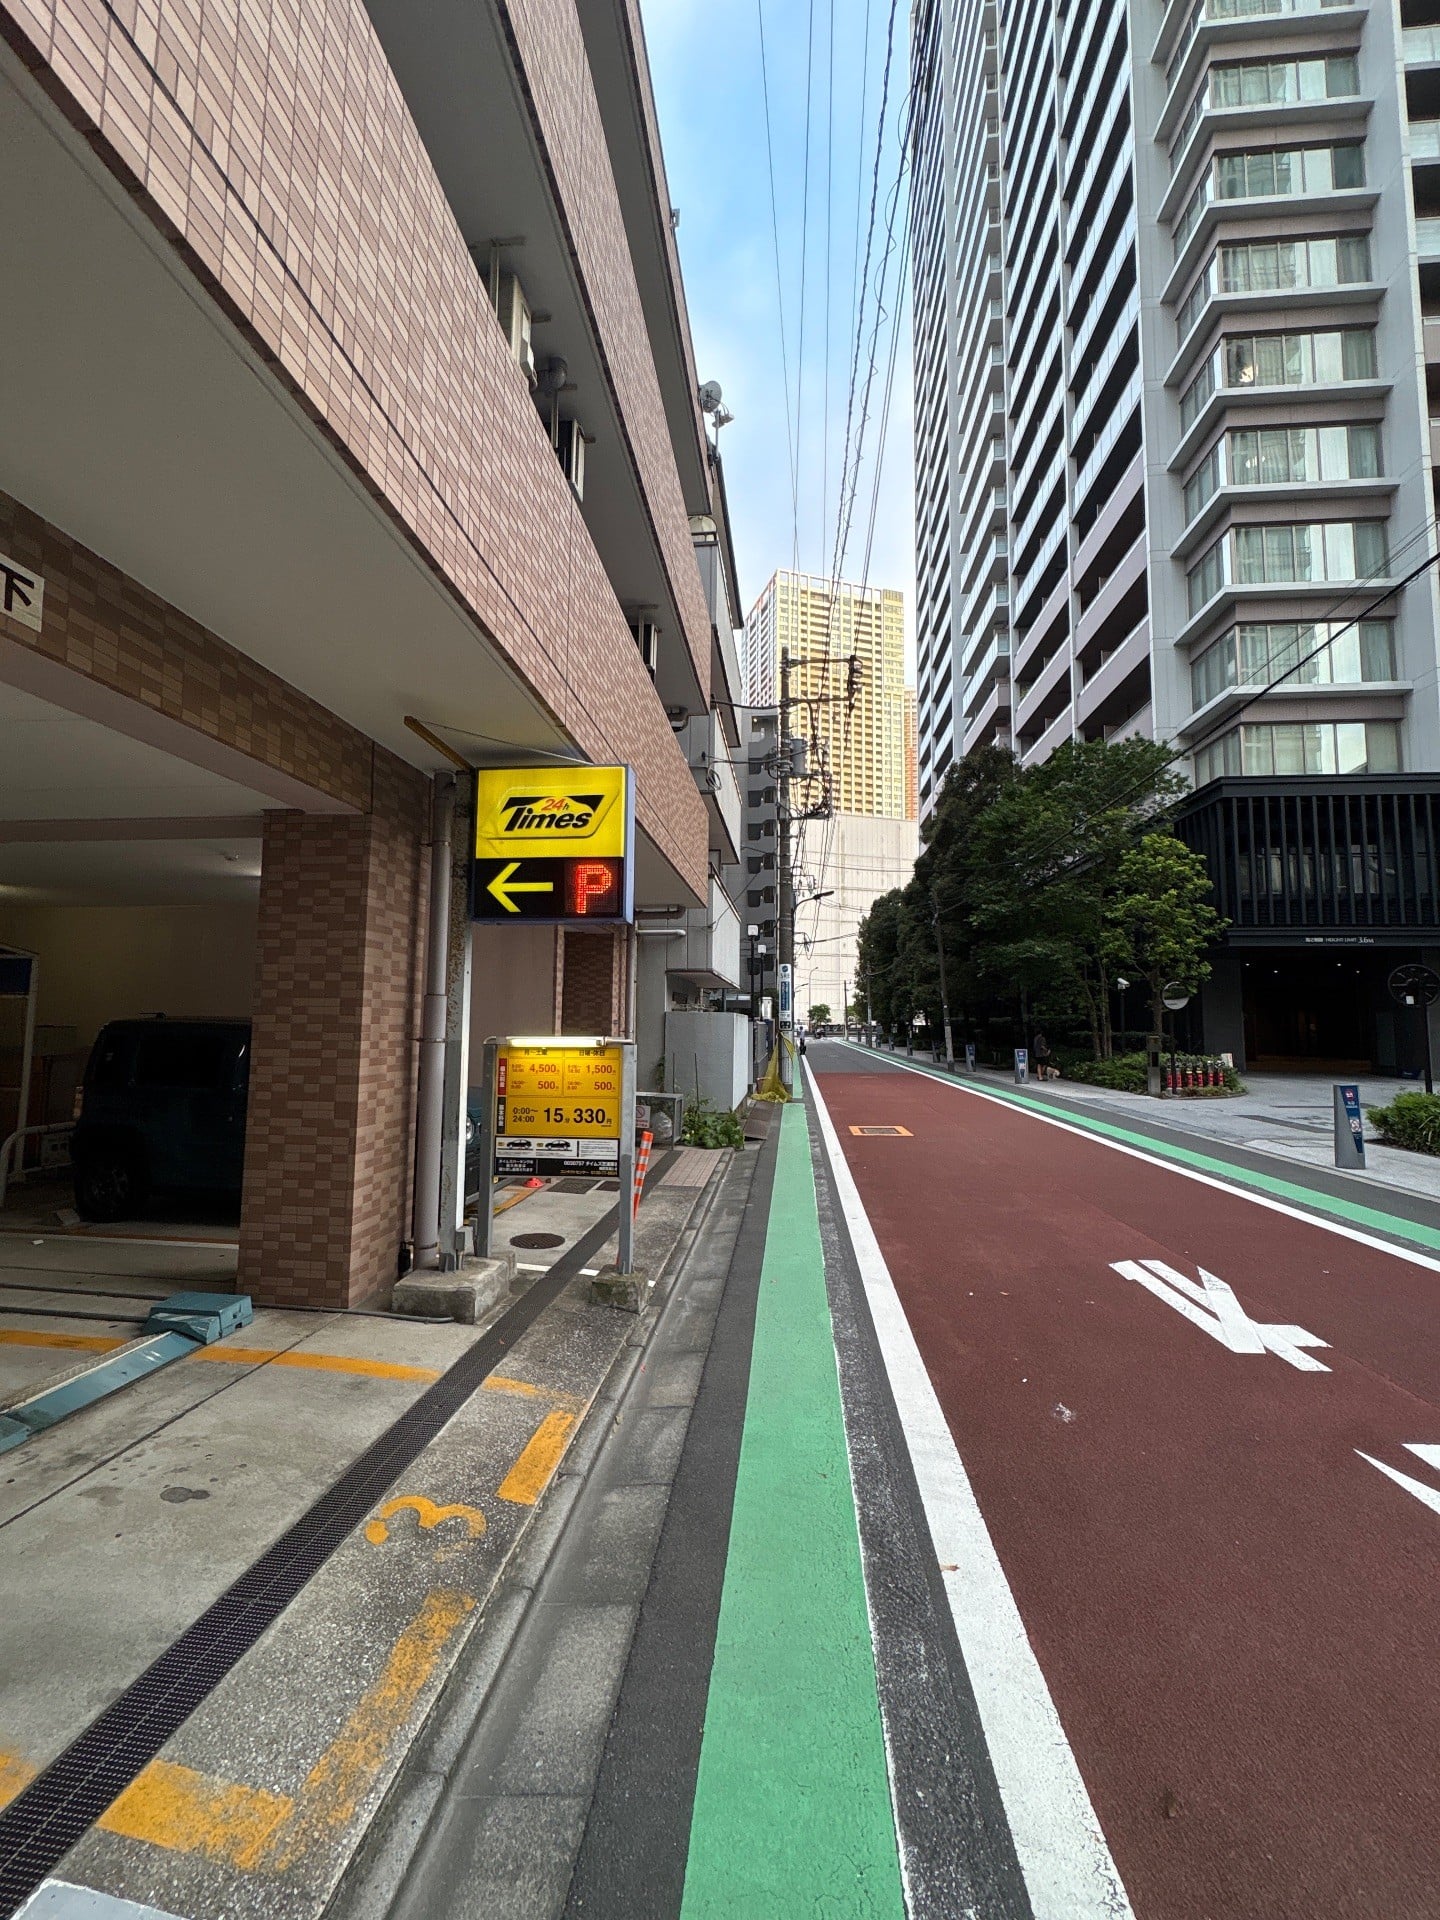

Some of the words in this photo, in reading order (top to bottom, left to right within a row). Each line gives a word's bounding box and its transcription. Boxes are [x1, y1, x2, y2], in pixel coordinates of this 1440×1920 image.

[501, 796, 600, 832] Times
[576, 864, 612, 914] P
[528, 1064, 559, 1074] 4,500
[586, 1065, 616, 1075] 1,500
[538, 1081, 559, 1090] 500
[594, 1081, 616, 1091] 500
[512, 1115, 535, 1123] 24:00
